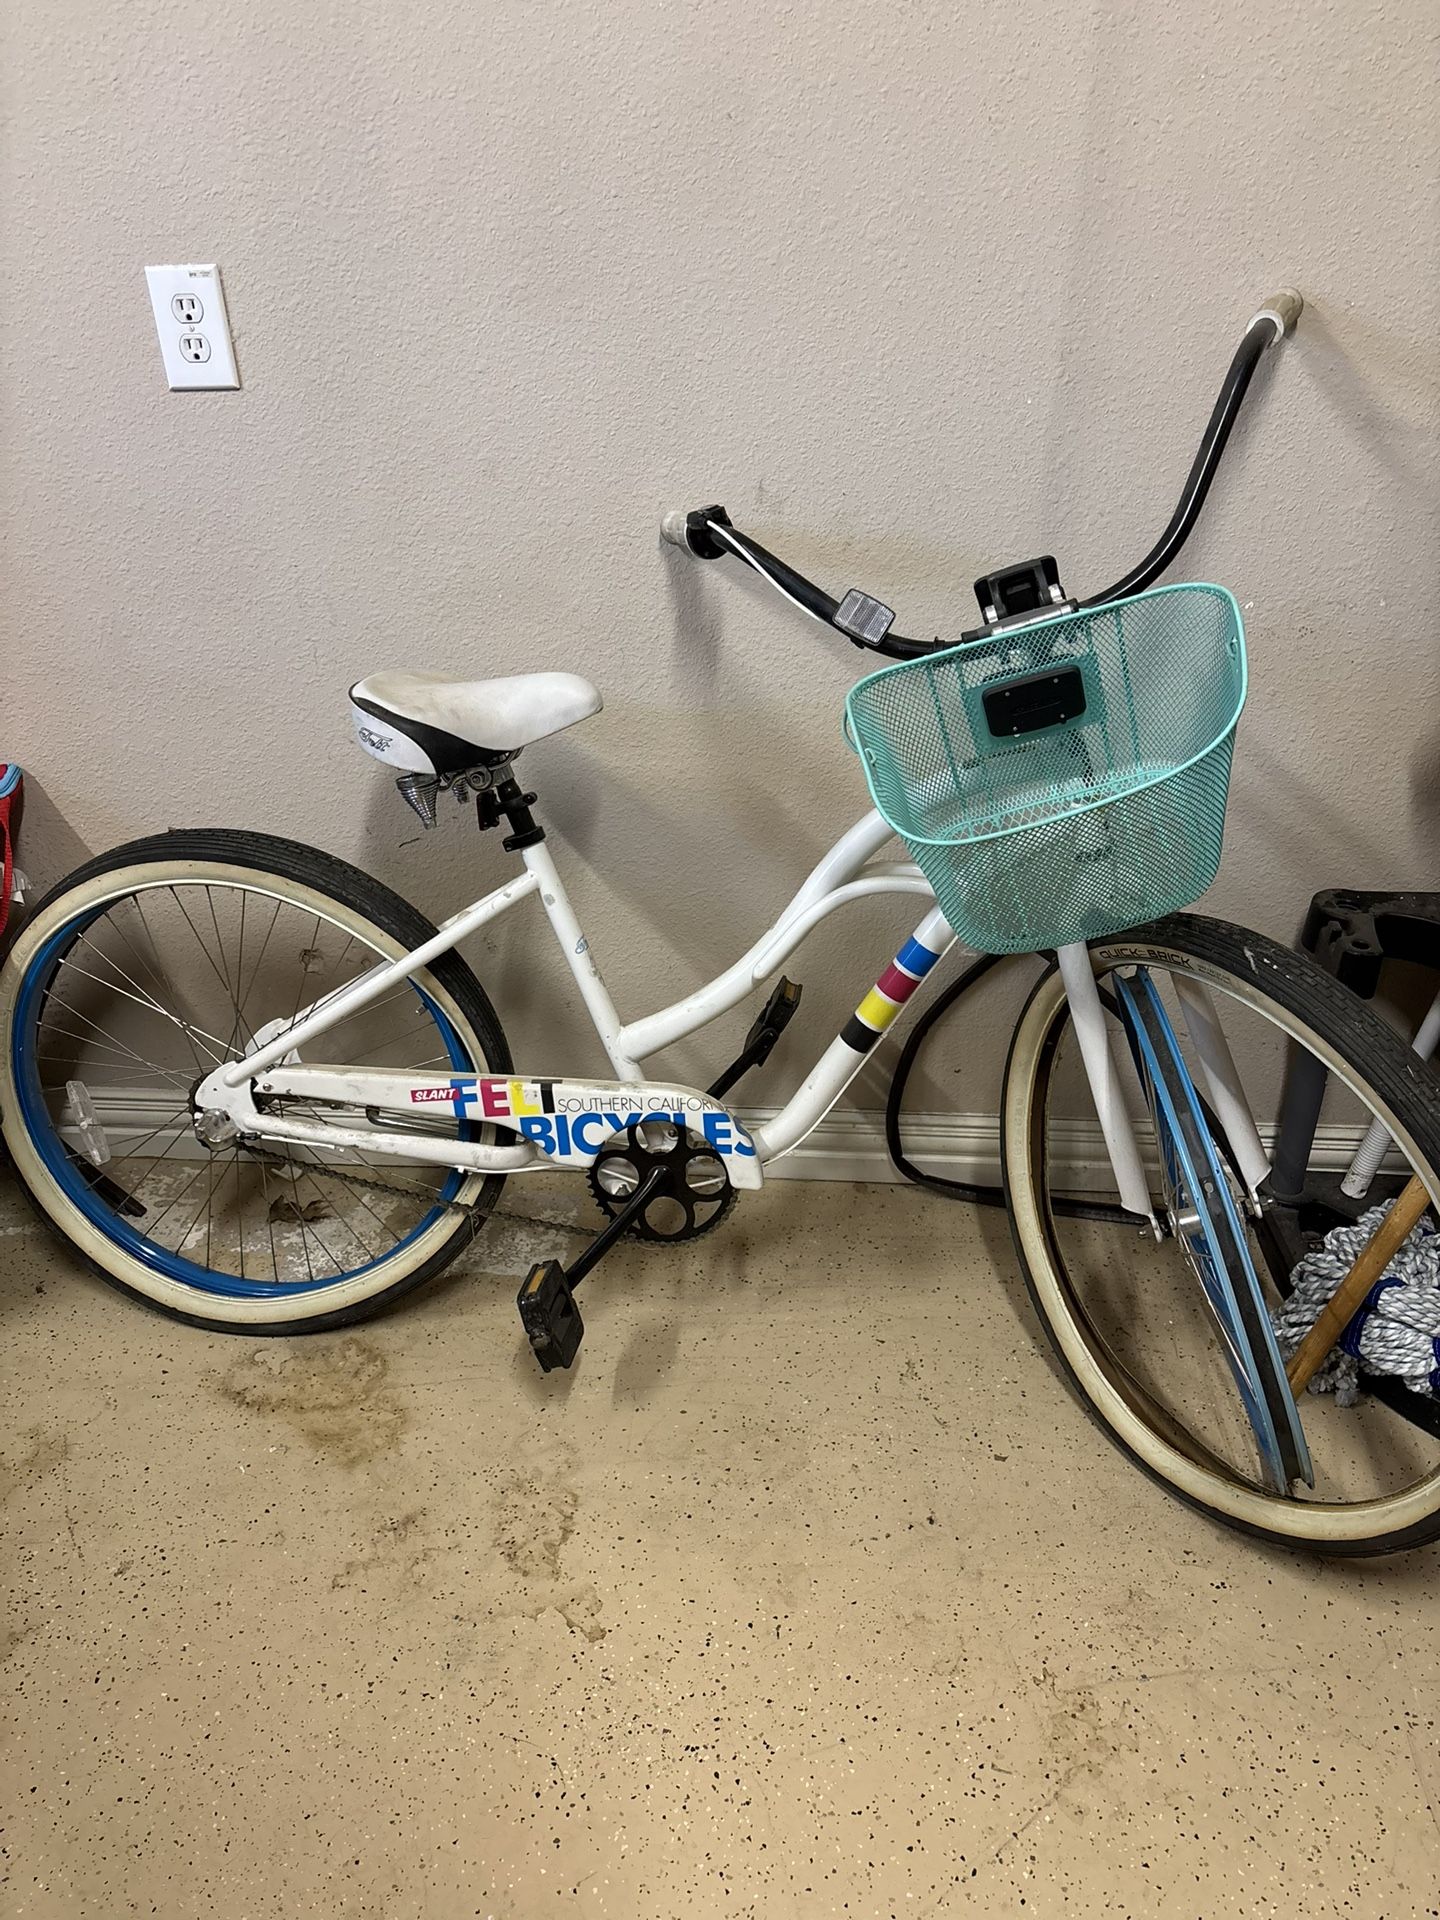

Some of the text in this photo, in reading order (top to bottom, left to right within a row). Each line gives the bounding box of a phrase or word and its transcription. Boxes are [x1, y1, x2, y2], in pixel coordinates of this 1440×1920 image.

[415, 1089, 456, 1101] SLANT
[450, 1079, 563, 1118] FELT
[558, 1098, 643, 1113] SOUTHERN
